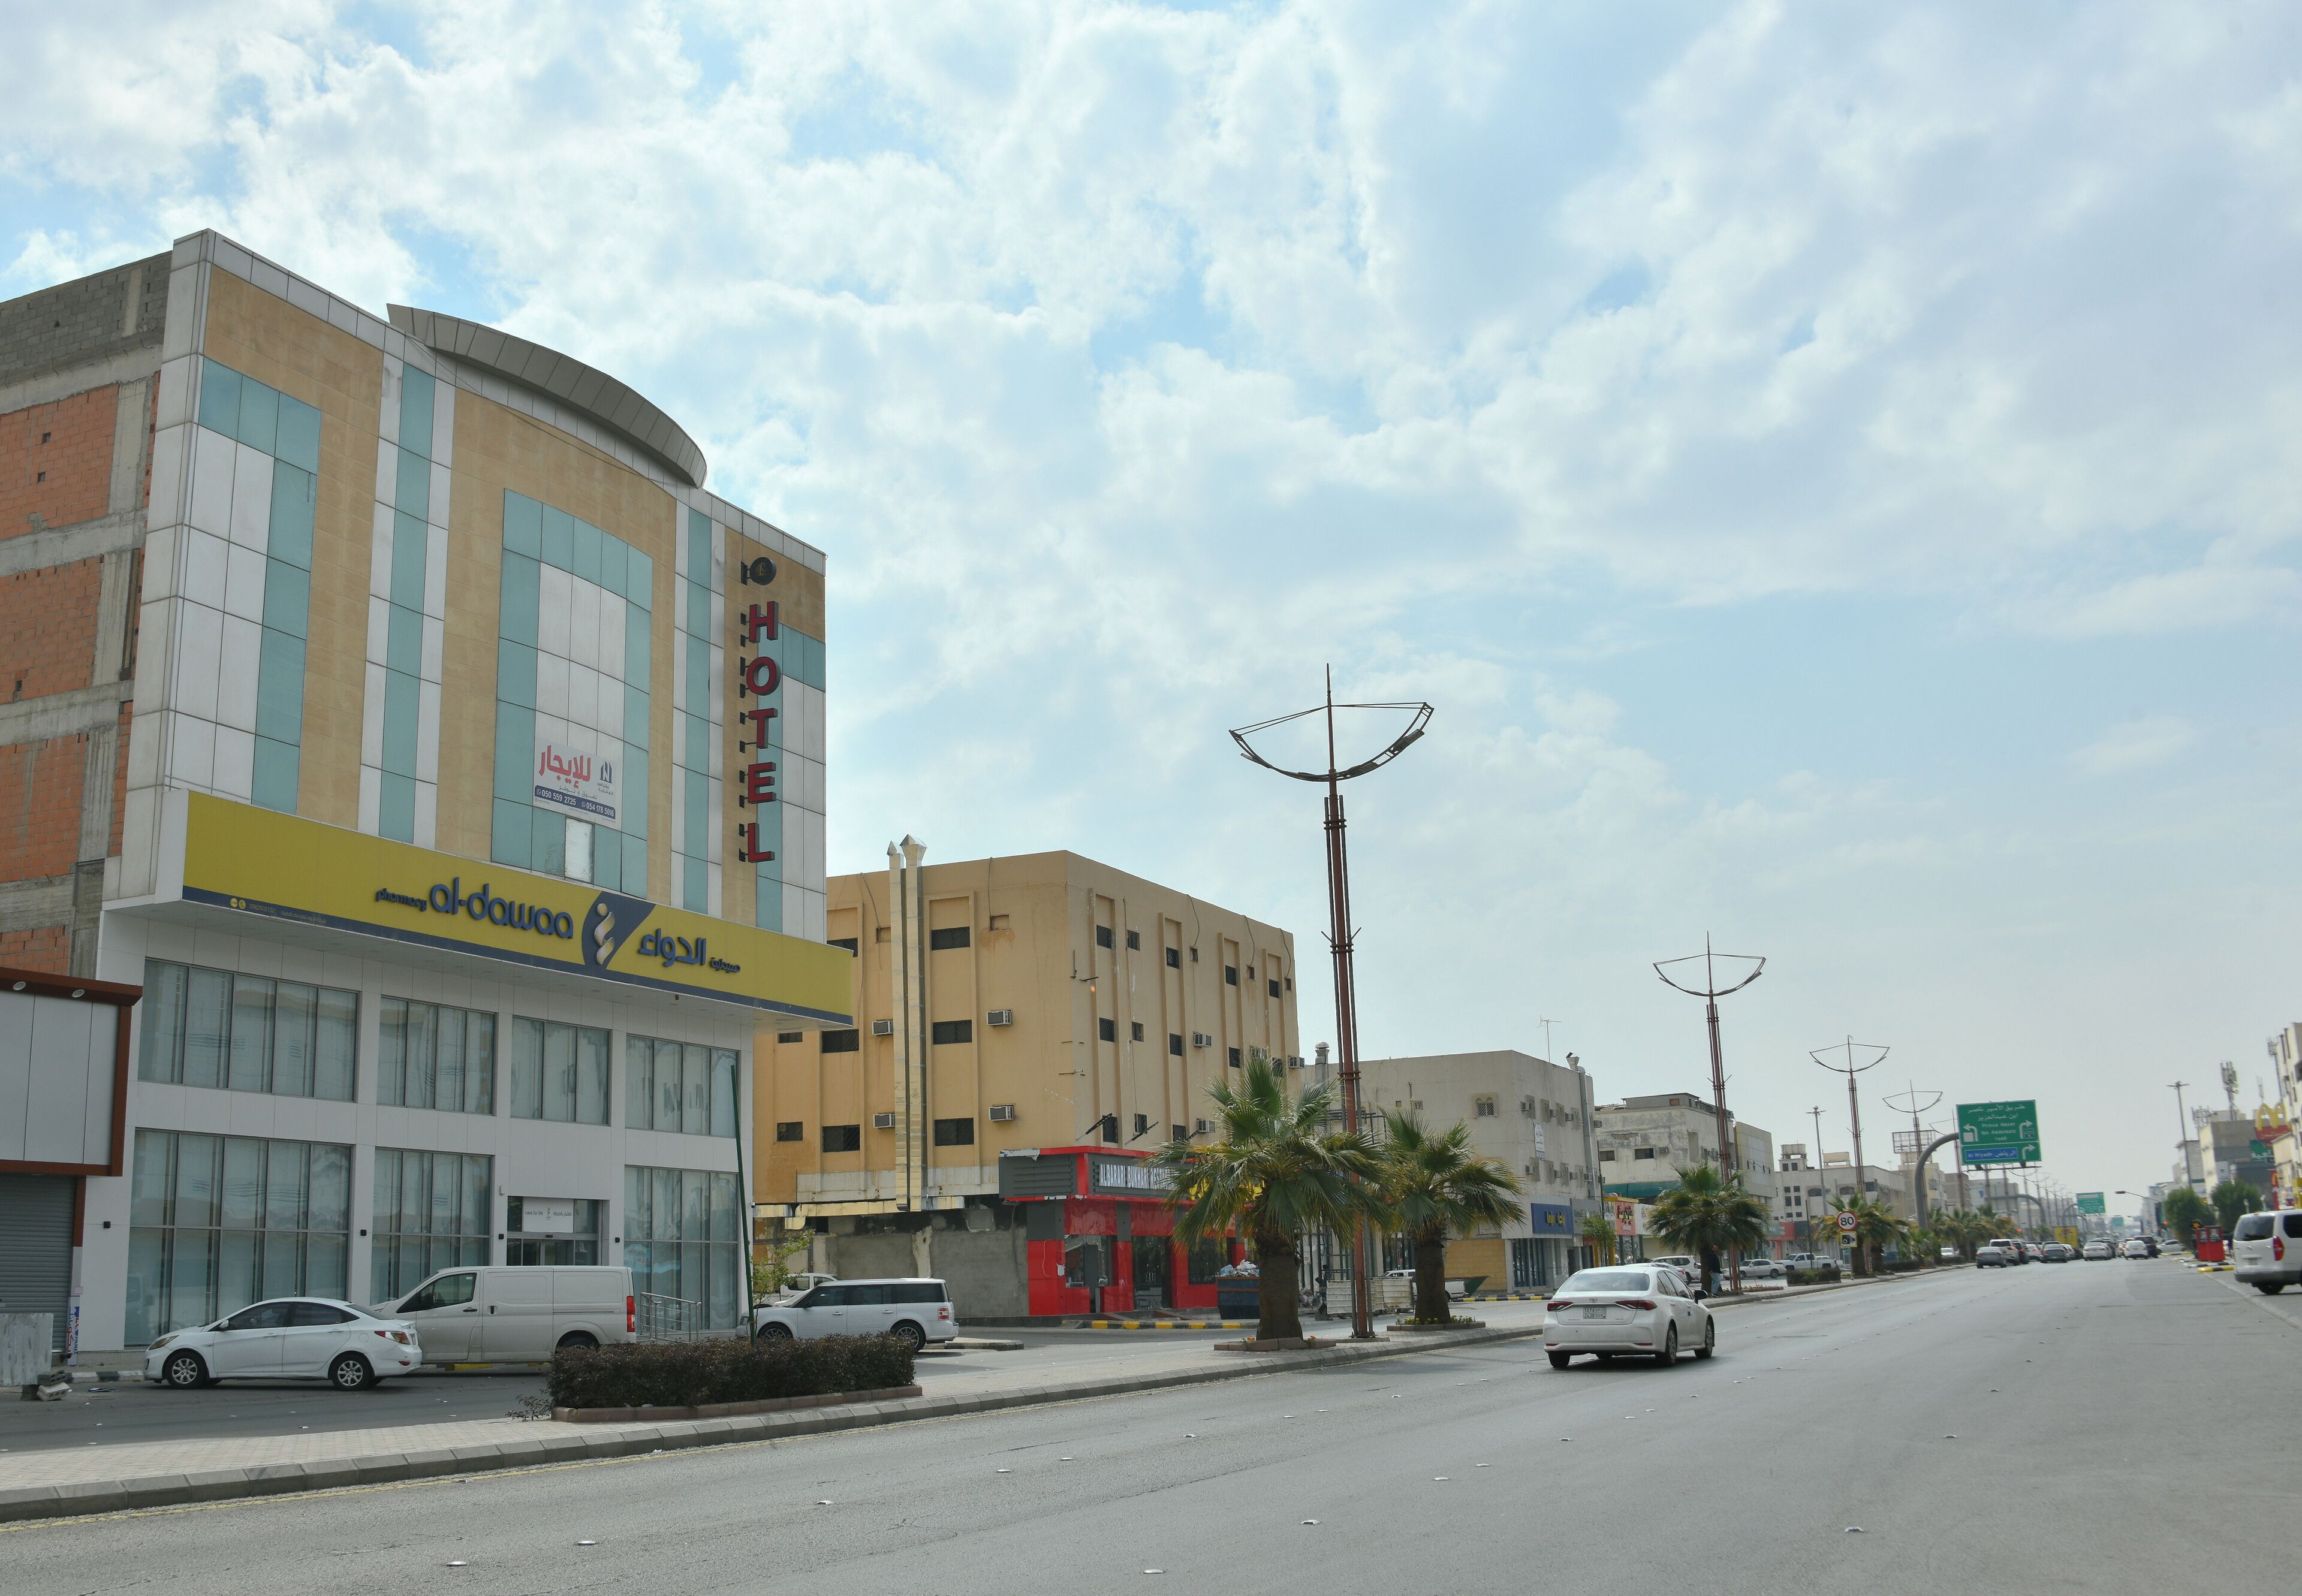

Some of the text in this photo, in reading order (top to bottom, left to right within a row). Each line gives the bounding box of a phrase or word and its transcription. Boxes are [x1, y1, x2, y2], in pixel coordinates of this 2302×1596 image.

[746, 601, 780, 863] HOTEL
[539, 745, 591, 789] للإيجار
[541, 789, 552, 798] 050
[553, 792, 562, 801] 559
[564, 796, 576, 805] 2725
[586, 802, 595, 811] 054
[604, 808, 614, 817] 5016
[375, 877, 574, 939] pharmacy al-dawaa
[638, 928, 741, 973] صيدلية الدواء
[1099, 1164, 1126, 1187] ALBARARI
[1127, 1165, 1149, 1189] BUKHARI
[1840, 1217, 1854, 1226] 80
